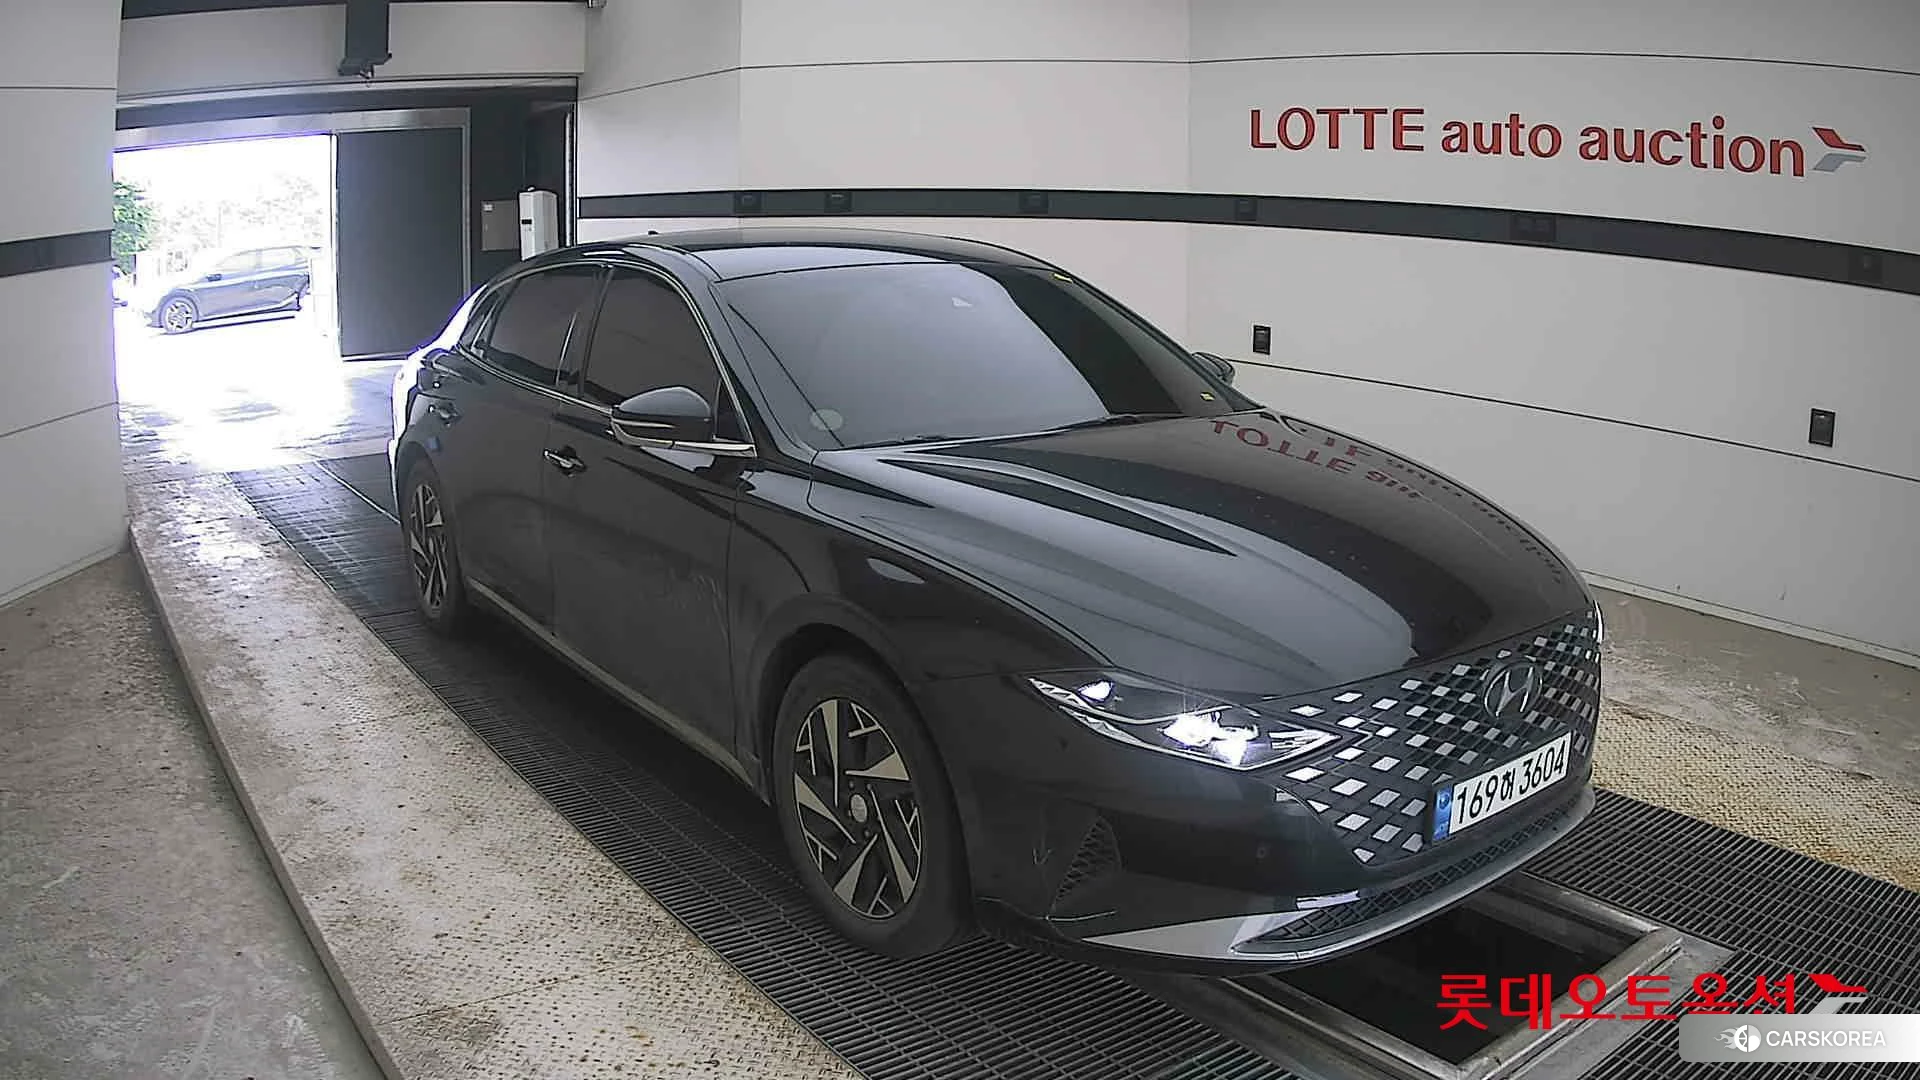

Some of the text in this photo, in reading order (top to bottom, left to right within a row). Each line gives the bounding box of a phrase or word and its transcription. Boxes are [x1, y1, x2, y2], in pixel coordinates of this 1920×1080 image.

[1250, 107, 1805, 178] LOTTE auto auction
[1456, 740, 1567, 825] 169허 3604
